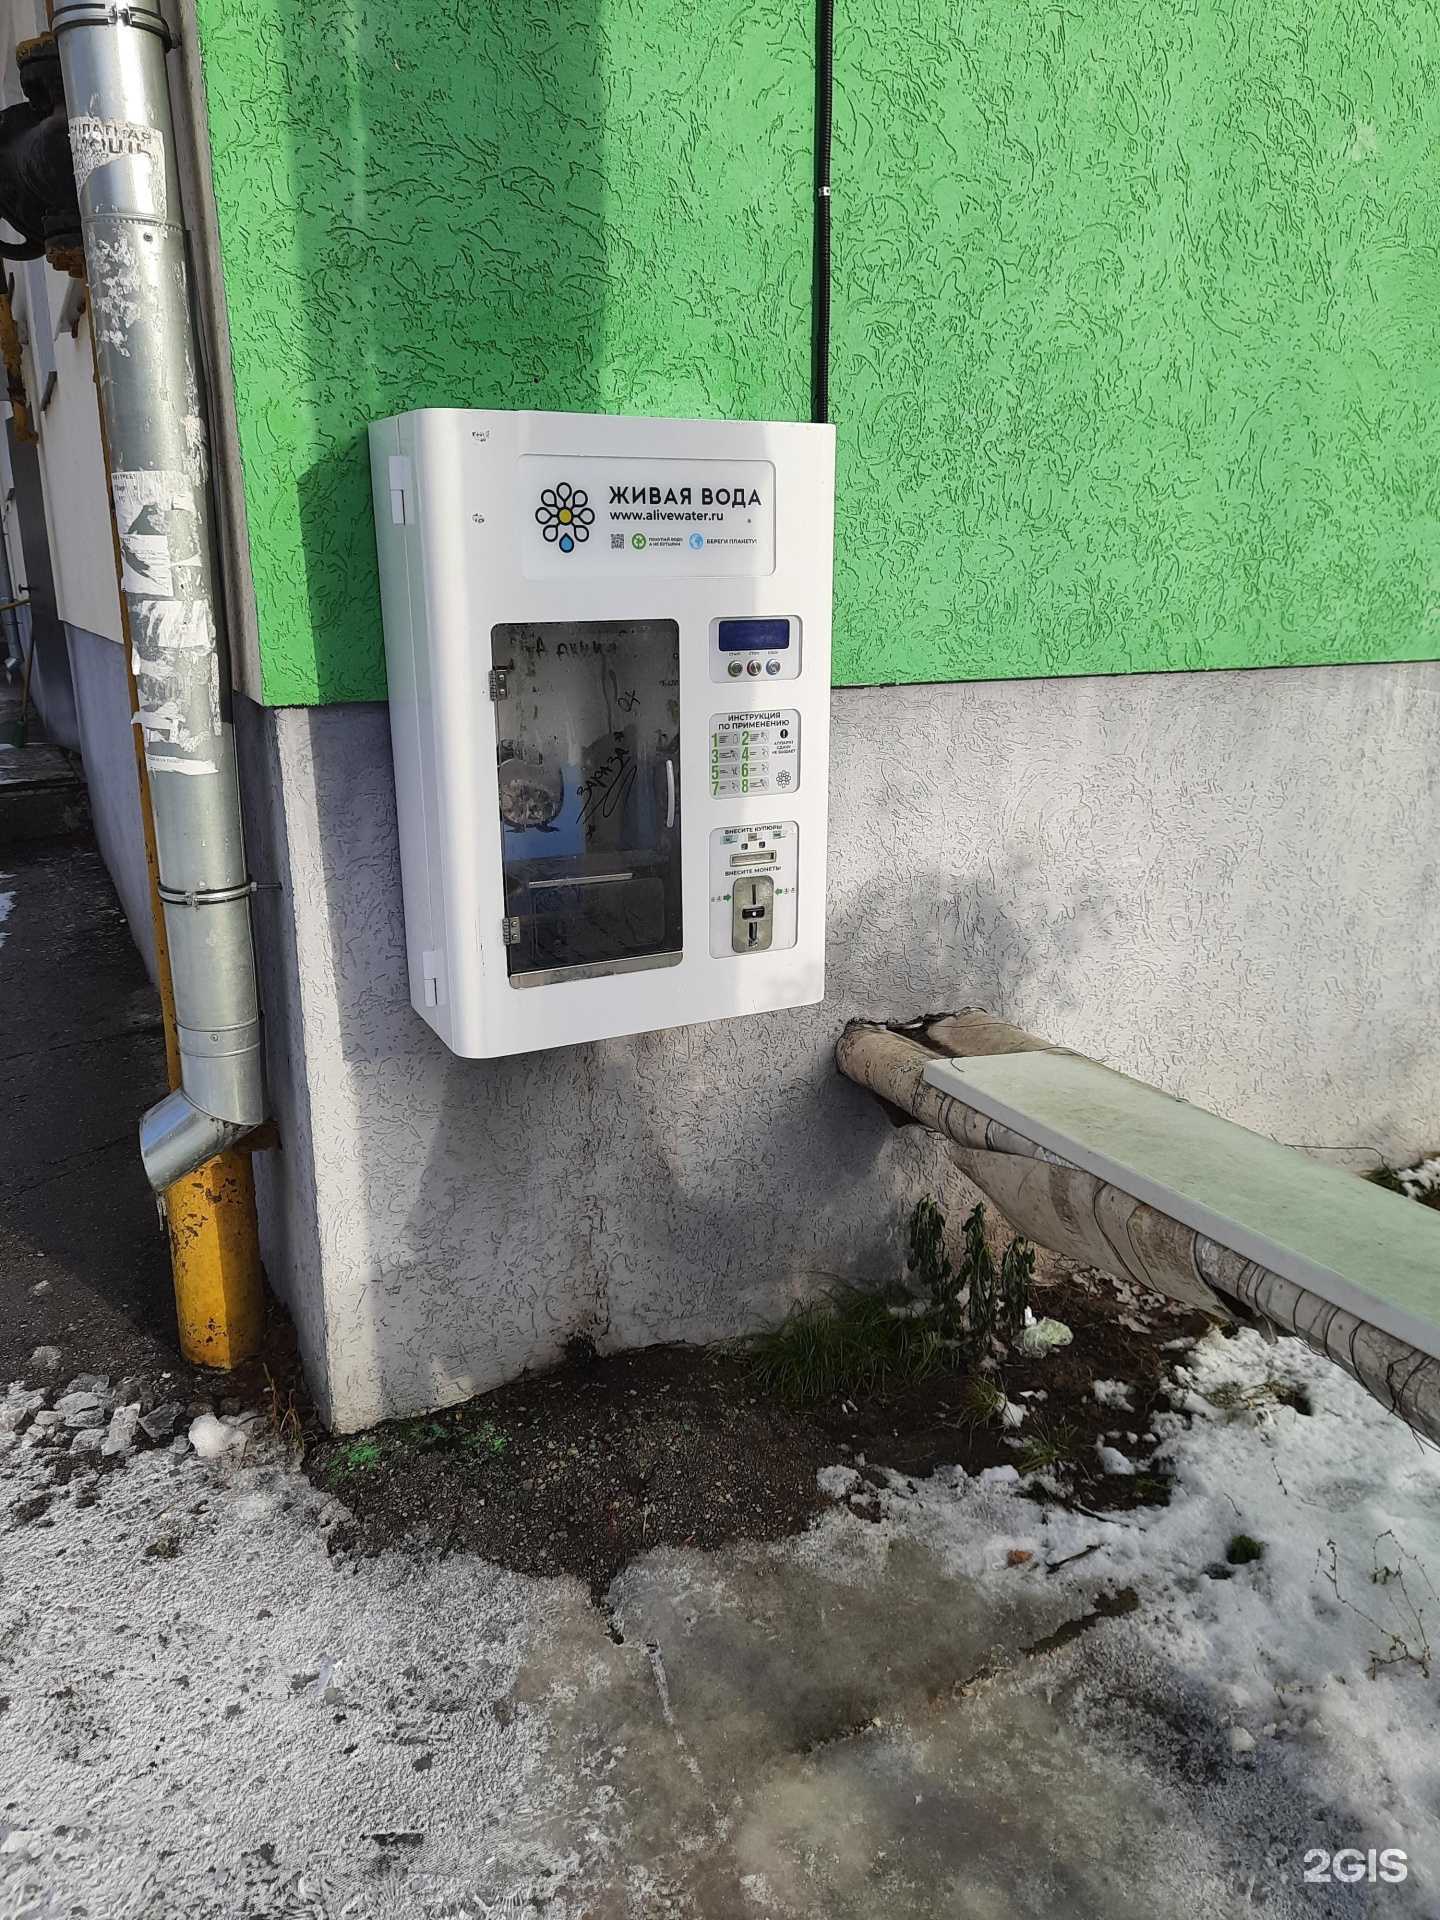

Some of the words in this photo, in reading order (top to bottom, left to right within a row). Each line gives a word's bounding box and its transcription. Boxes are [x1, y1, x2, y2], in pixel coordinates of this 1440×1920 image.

[609, 486, 692, 505] ЖИВАЯ
[701, 488, 762, 508] ВОДА
[609, 510, 724, 522] www.alivewater.ru
[728, 712, 781, 722] ИНСТРУКЦИЯ
[718, 723, 730, 731] ПО
[732, 720, 790, 730] ПРИМЕНЕНИЮ
[711, 733, 718, 748] 1
[741, 731, 750, 746] 2
[711, 749, 719, 764] 3
[741, 746, 749, 762] 4
[711, 765, 719, 780] 5
[741, 763, 749, 778] 6
[711, 781, 720, 796] 7
[741, 779, 749, 793] 8
